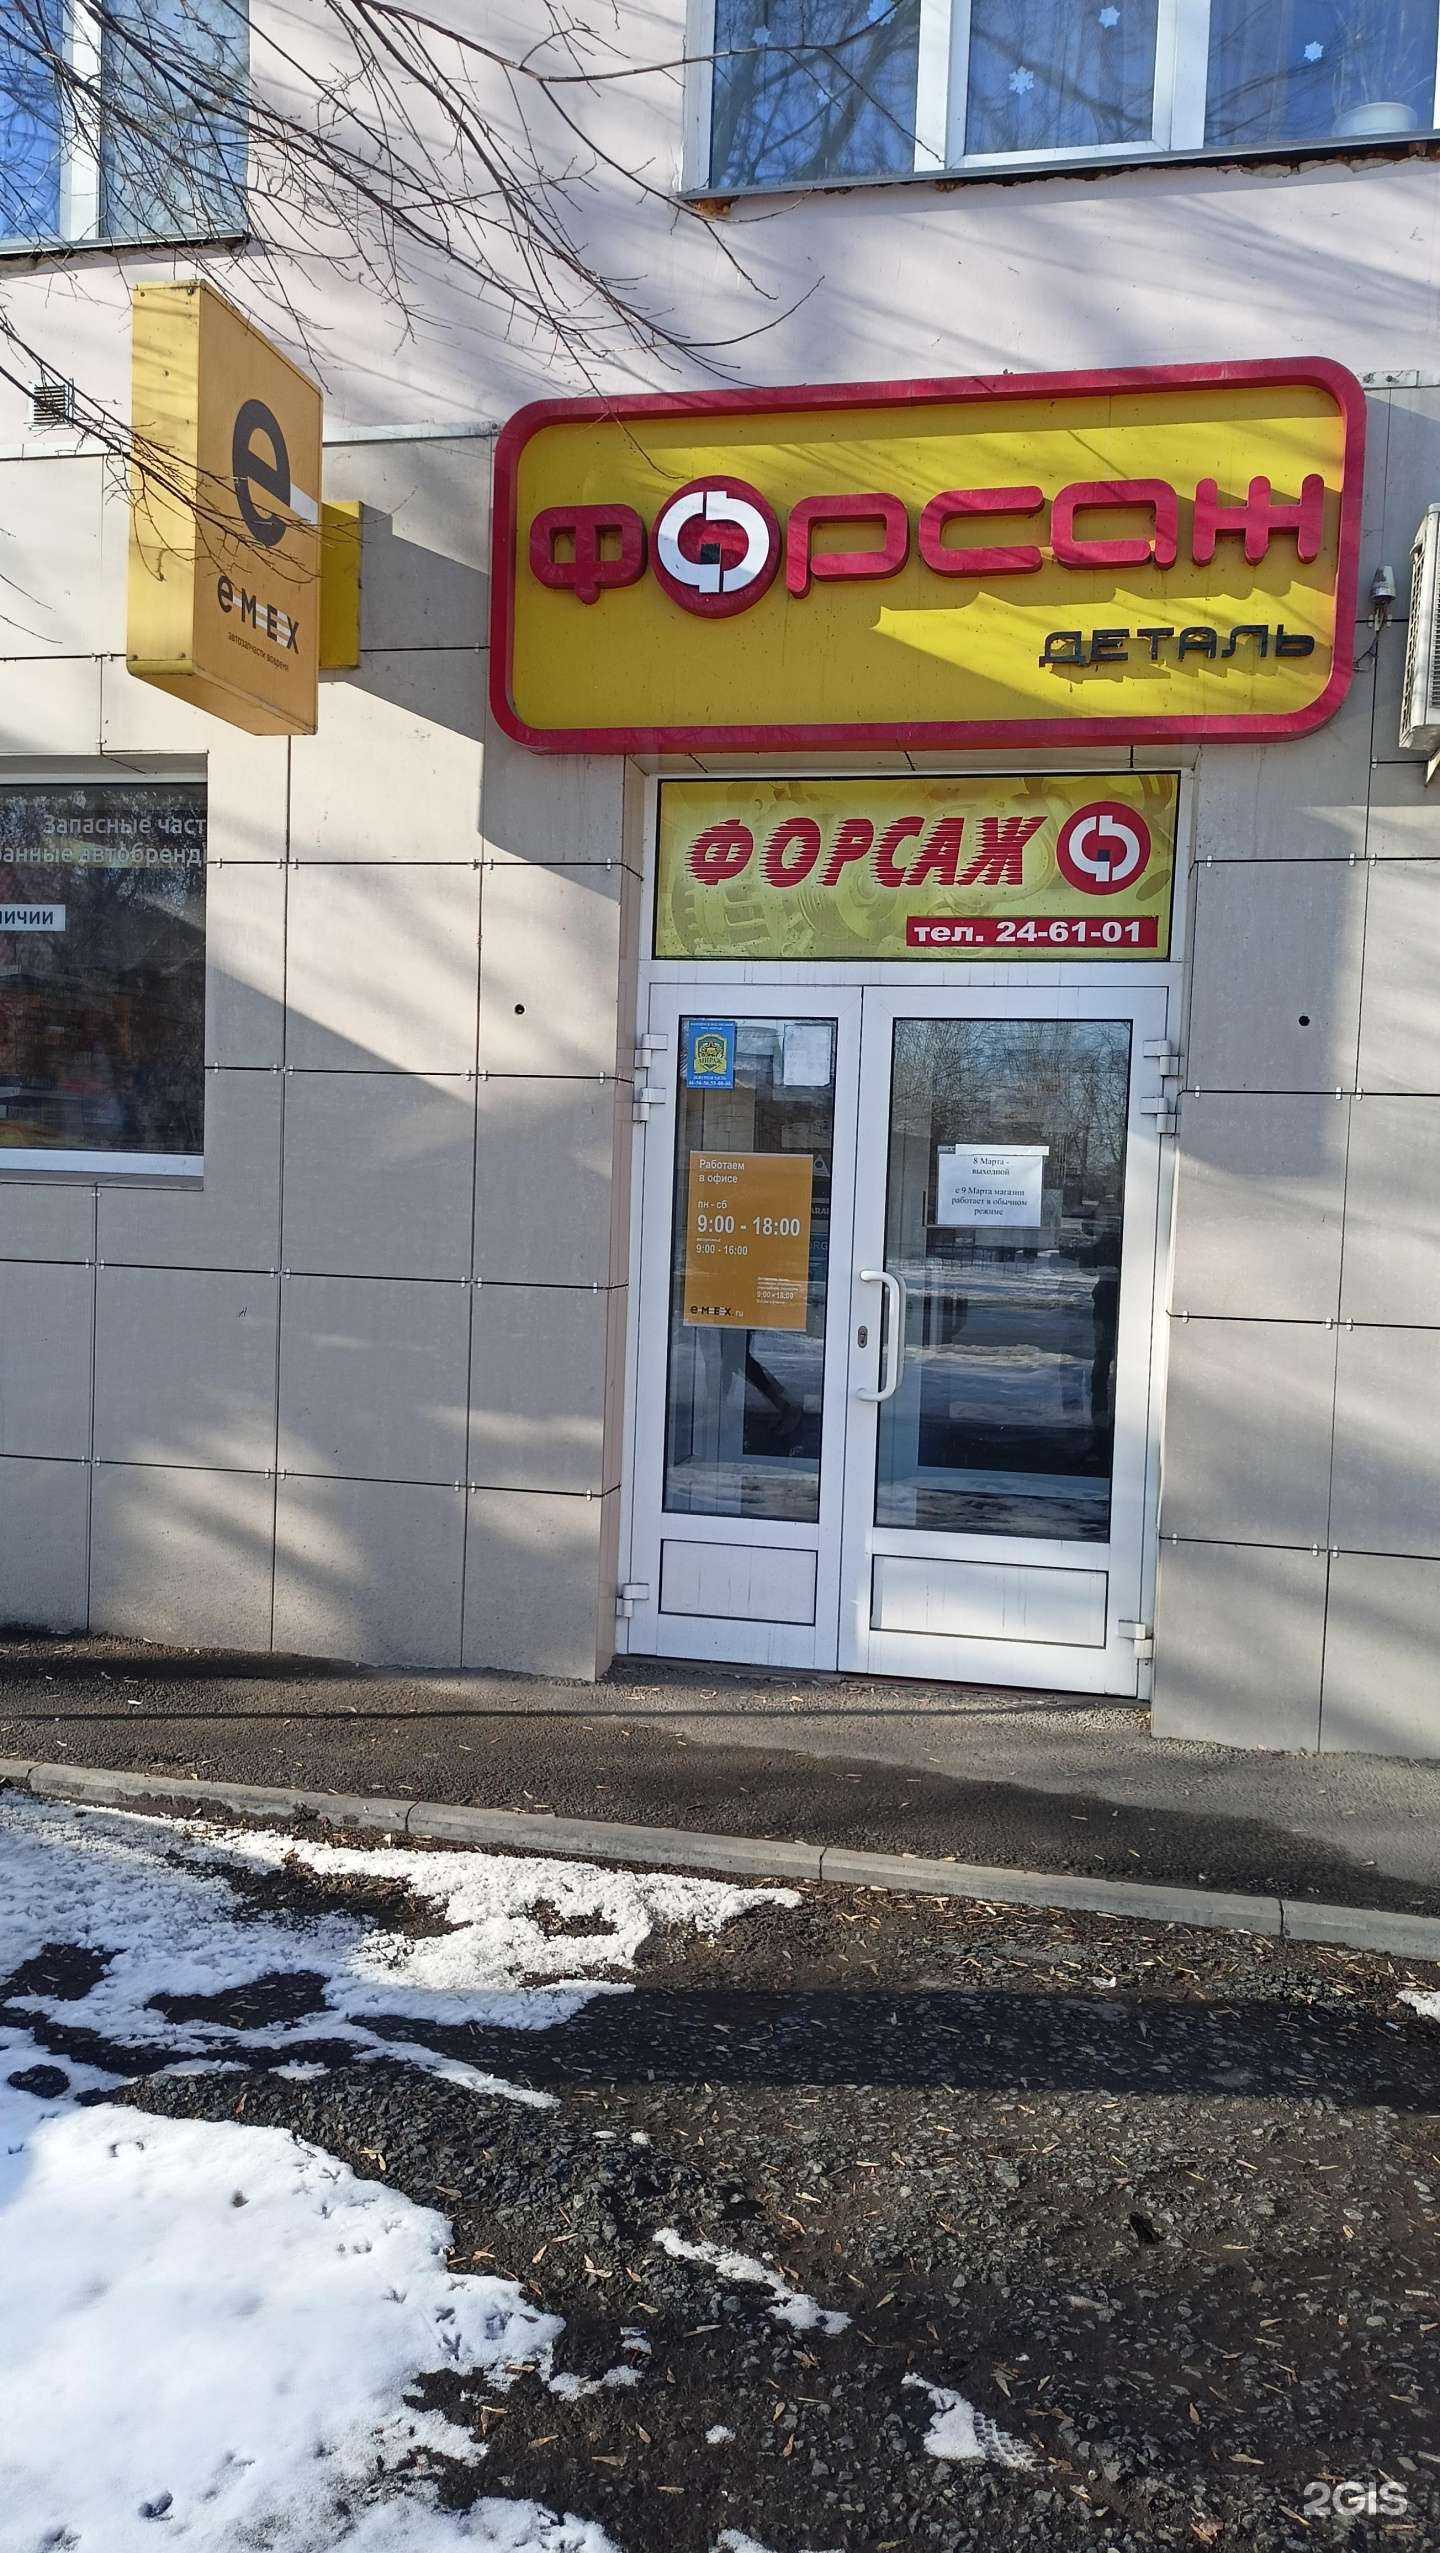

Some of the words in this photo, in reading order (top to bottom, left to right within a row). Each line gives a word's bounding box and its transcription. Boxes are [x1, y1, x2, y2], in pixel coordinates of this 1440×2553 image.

[1040, 625, 1316, 667] ДЕТАЛЬ
[43, 816, 150, 838] Запасные
[685, 815, 1048, 888] ФОРСАЖ
[0, 910, 54, 925] ичии
[913, 923, 984, 943] тел.
[996, 921, 1140, 942] 24-61-01
[699, 1159, 745, 1170] Работаем
[980, 1157, 1005, 1167] Марта
[971, 1168, 1010, 1176] выходной
[699, 1174, 705, 1182] в
[707, 1173, 738, 1184] офисе
[961, 1186, 967, 1194] 9
[968, 1187, 993, 1197] Марта
[698, 1201, 709, 1209] пн
[716, 1200, 728, 1209] сб
[951, 1197, 985, 1206] работает
[697, 1214, 735, 1233] 9:00
[752, 1216, 801, 1236] 18:00
[696, 1244, 715, 1254] 9:00
[724, 1245, 748, 1256] 16:00
